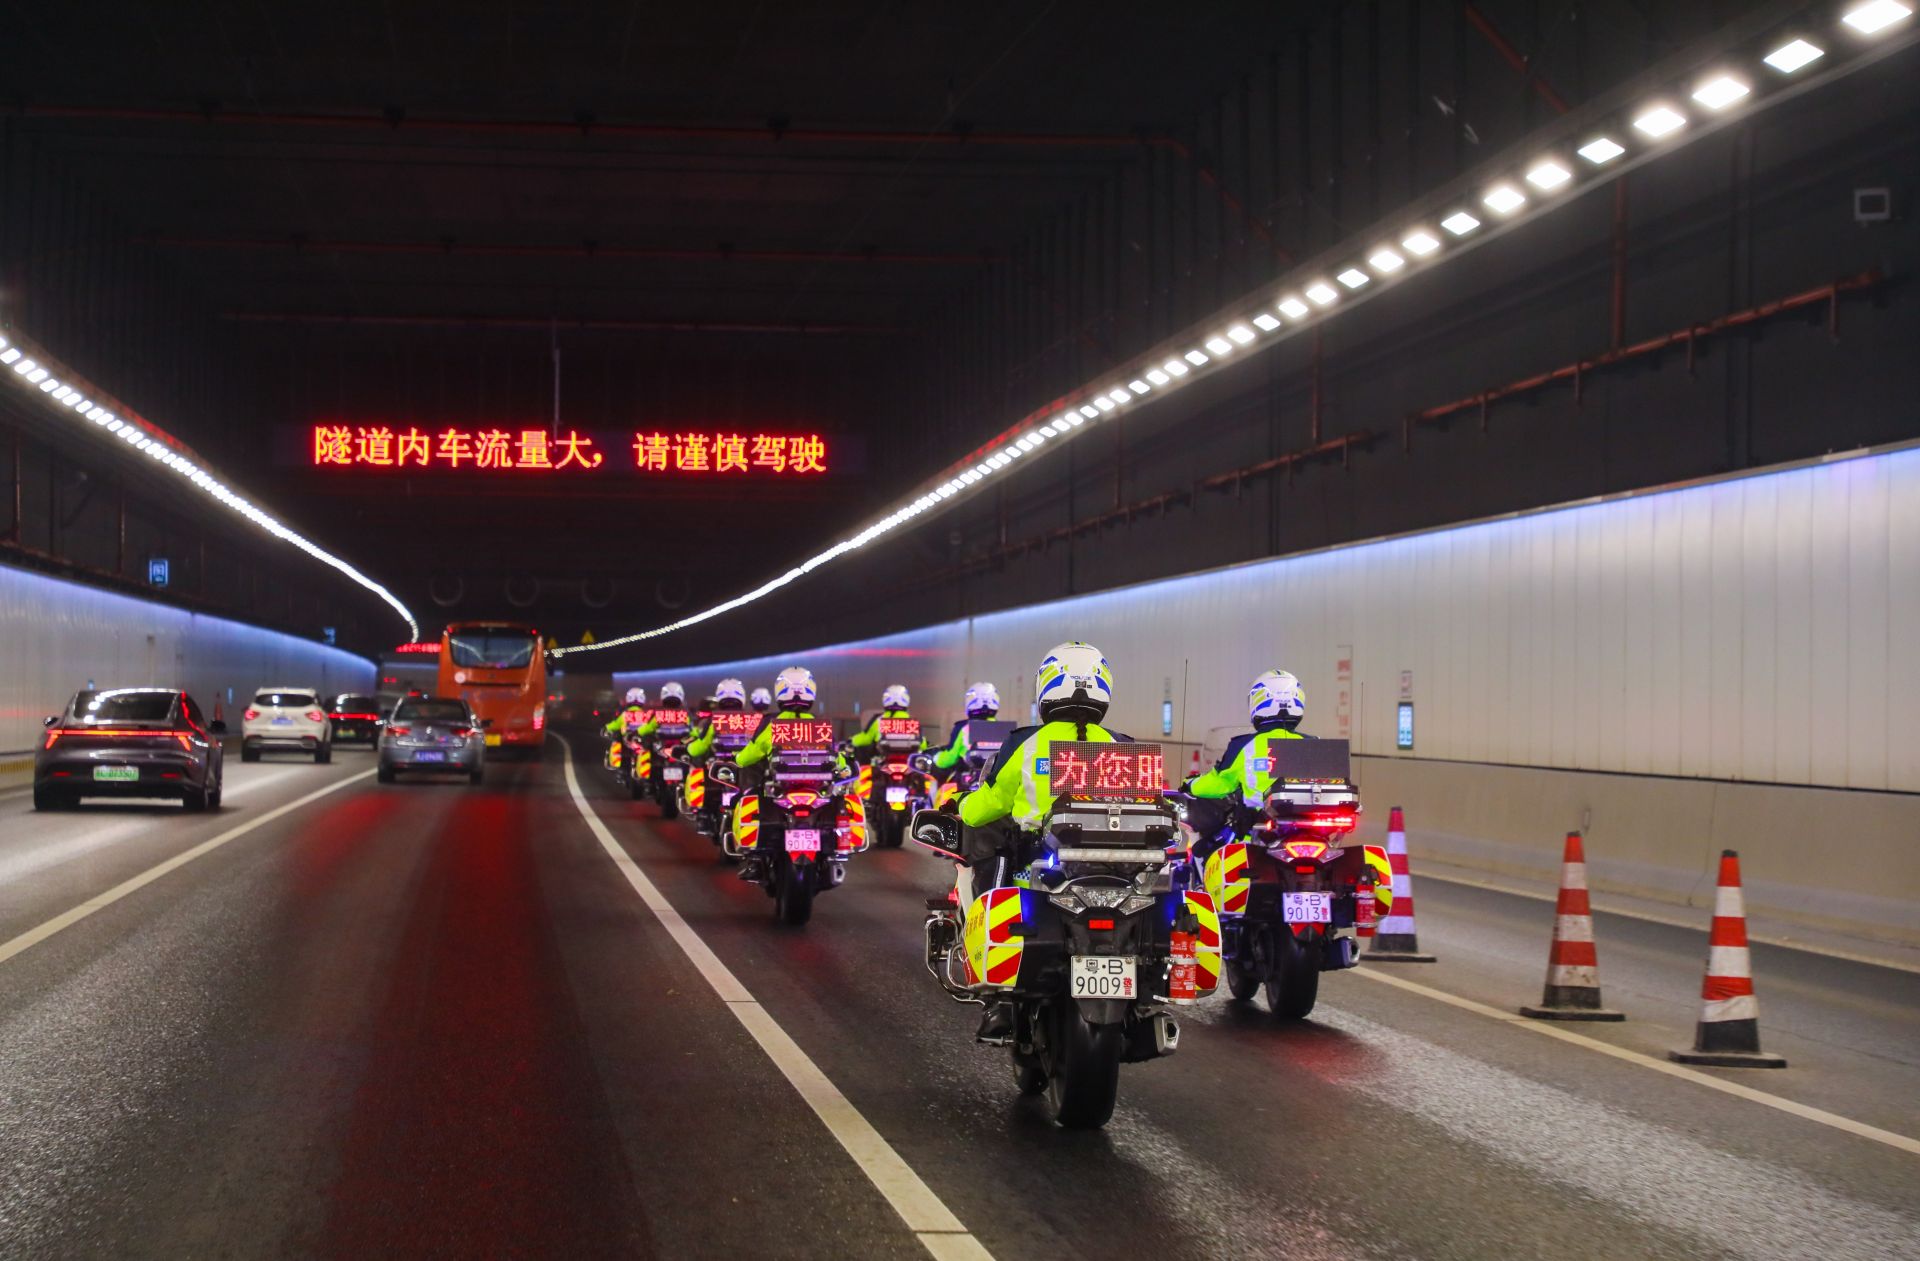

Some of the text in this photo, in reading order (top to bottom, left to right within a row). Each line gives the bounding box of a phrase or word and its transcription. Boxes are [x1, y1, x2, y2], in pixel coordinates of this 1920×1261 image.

[632, 432, 827, 472] 请谨慎驾驶
[771, 722, 832, 743] 深圳交
